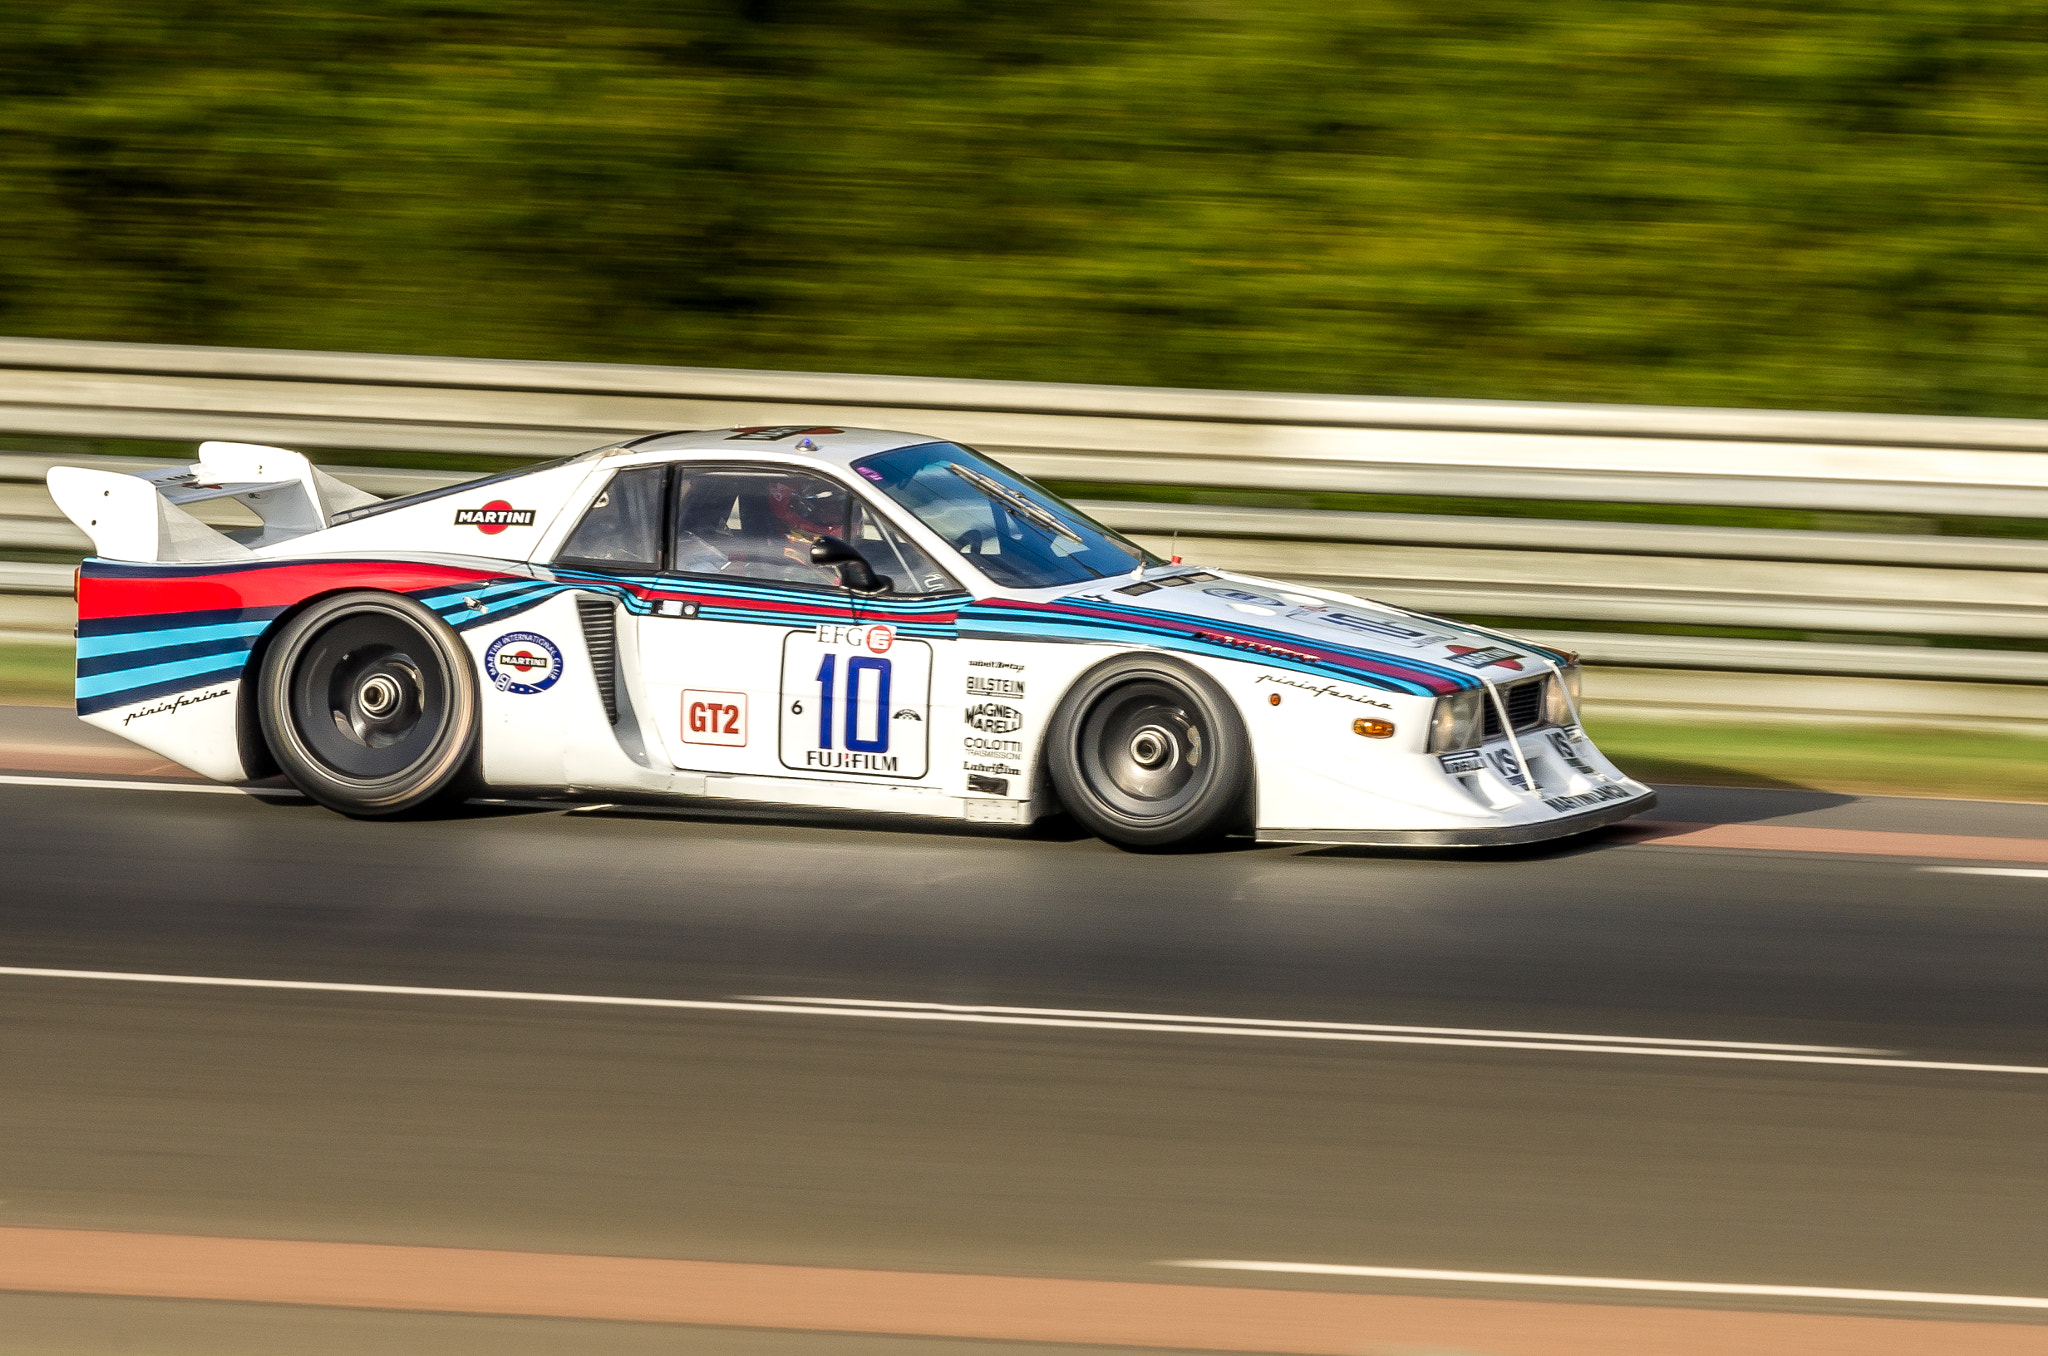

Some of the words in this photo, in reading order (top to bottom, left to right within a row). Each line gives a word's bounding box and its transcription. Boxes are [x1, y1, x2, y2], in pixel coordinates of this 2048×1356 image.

[458, 511, 532, 524] MARTINI
[816, 625, 863, 646] EFG
[501, 656, 546, 666] MARTINI
[967, 676, 1026, 693] BILSTEIN
[1255, 674, 1394, 710] pininfarina
[123, 689, 231, 726] pininfarina
[791, 700, 804, 715] 6
[816, 654, 892, 753] 10
[689, 702, 740, 734] GT2
[964, 737, 1022, 752] COLOTTI
[806, 751, 898, 771] FUJIFILM
